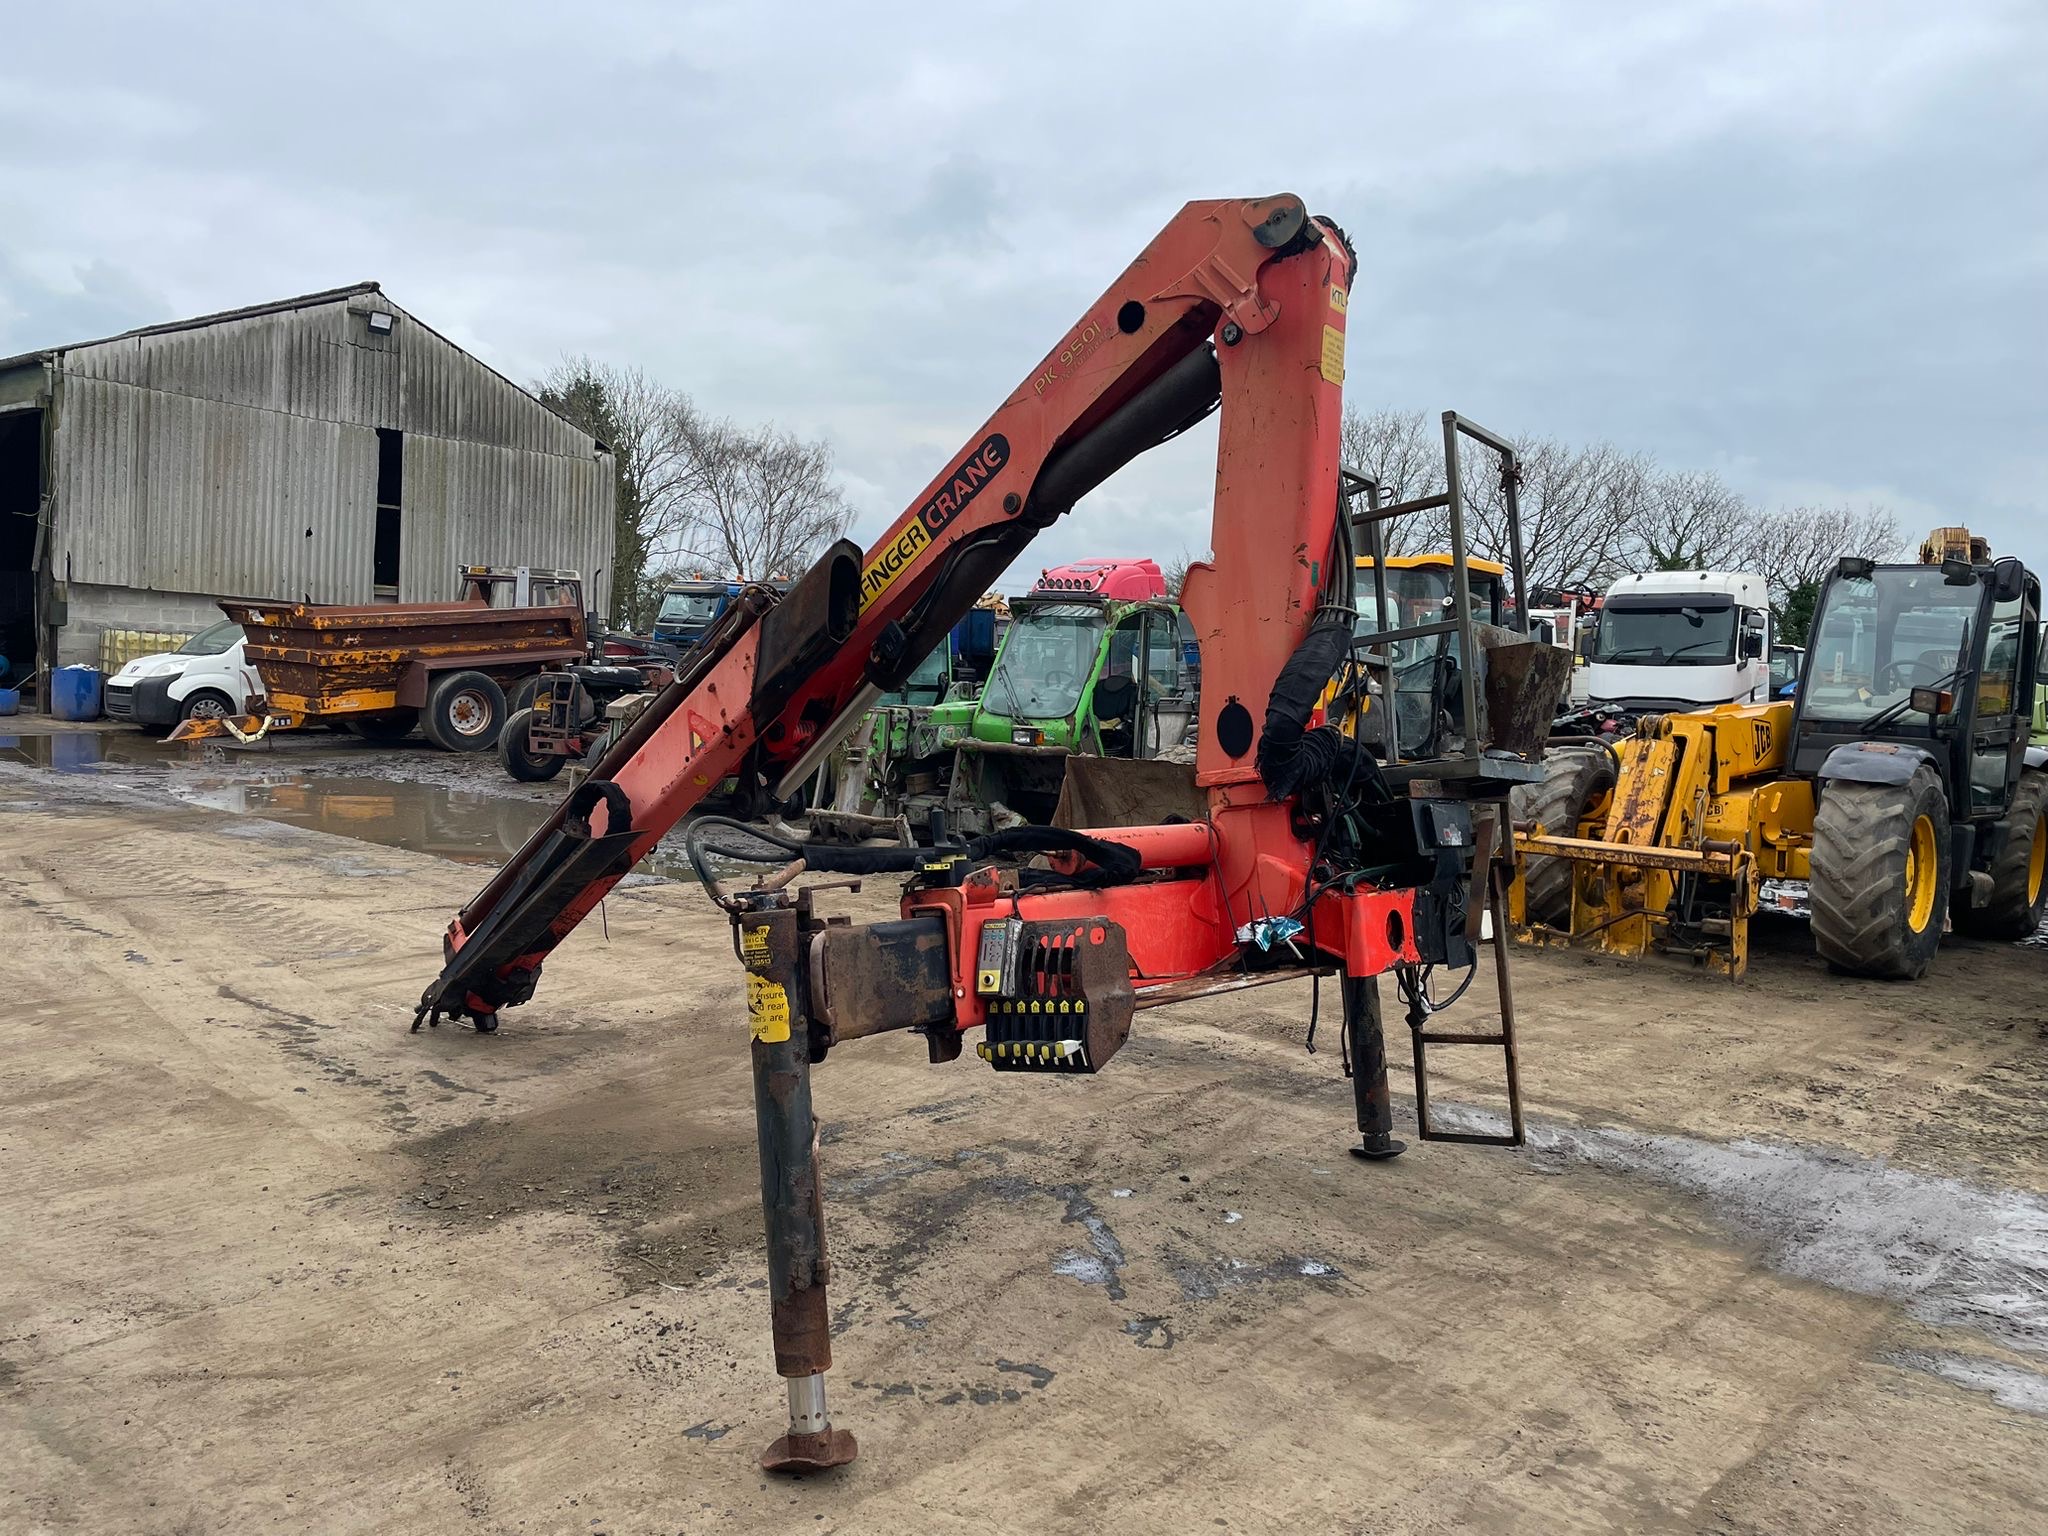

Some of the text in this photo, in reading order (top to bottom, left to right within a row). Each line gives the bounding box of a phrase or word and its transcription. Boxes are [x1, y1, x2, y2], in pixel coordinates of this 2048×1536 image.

[1332, 288, 1344, 307] KTL
[1034, 366, 1058, 395] PK
[859, 442, 1002, 608] FINGER CRANE
[1754, 724, 1771, 761] JCB
[756, 991, 784, 1000] ensure
[770, 1014, 784, 1022] are
